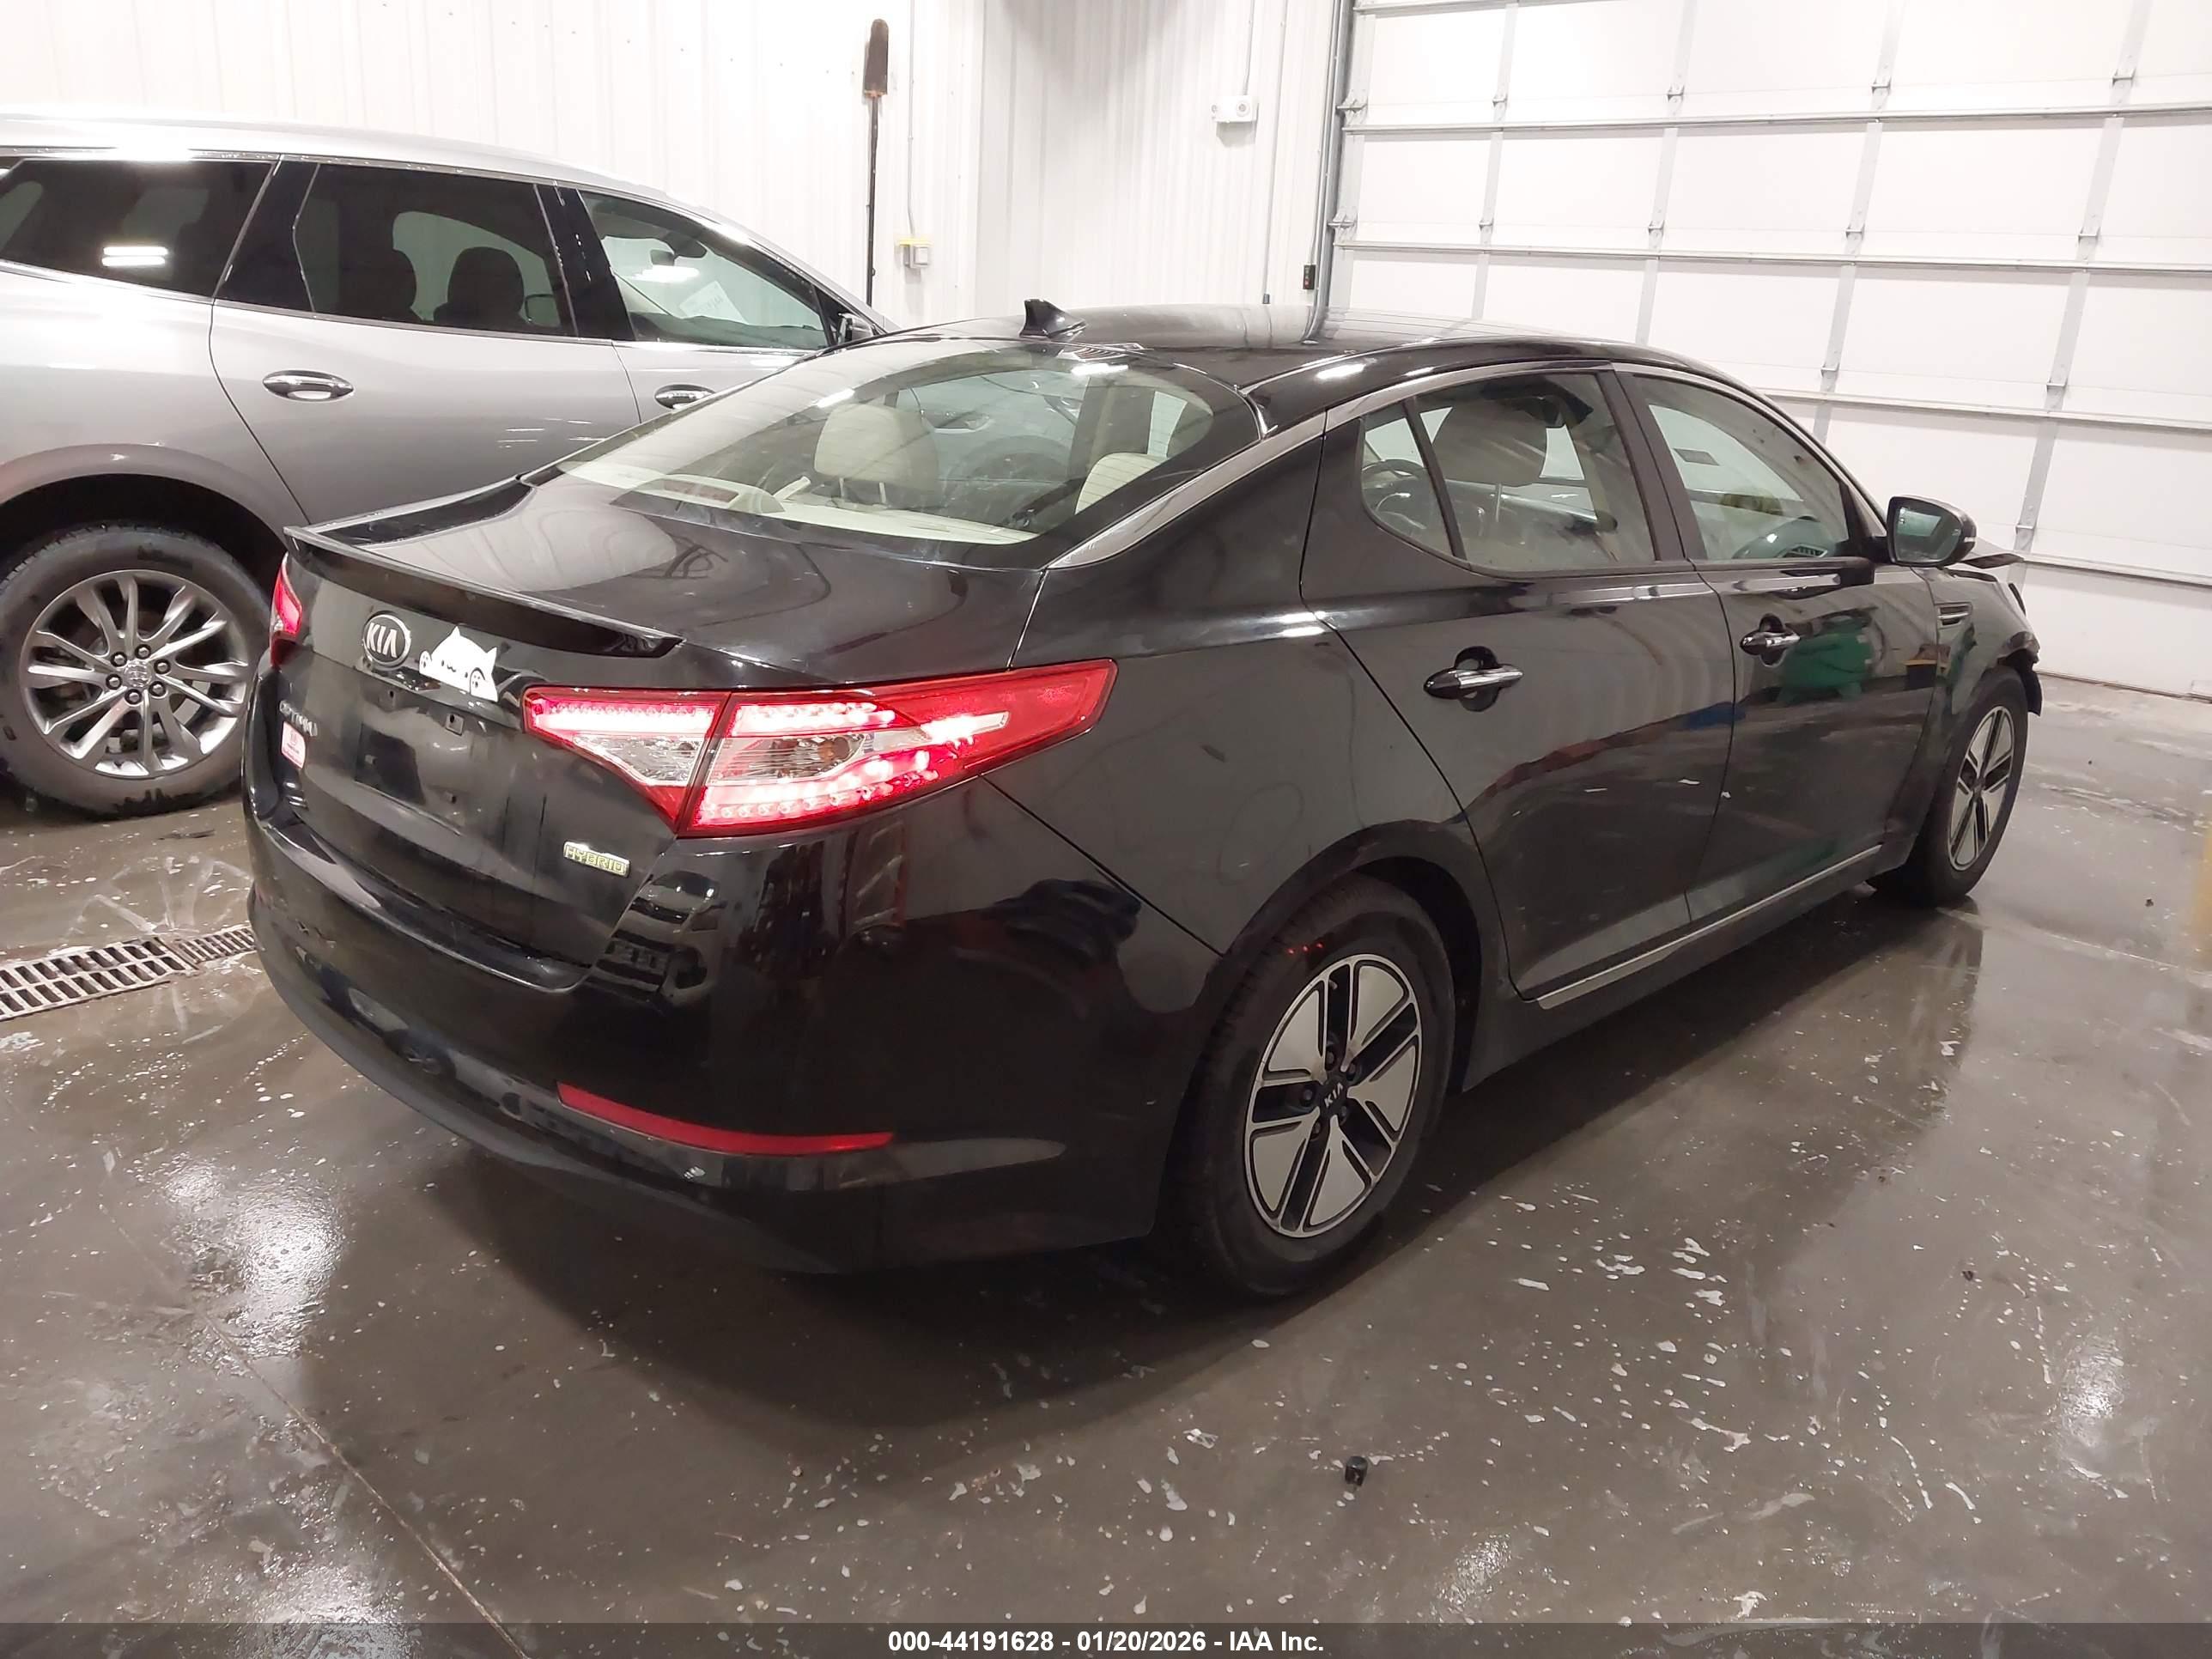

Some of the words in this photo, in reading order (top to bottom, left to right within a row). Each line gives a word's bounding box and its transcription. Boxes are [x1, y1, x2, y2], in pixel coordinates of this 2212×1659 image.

[366, 622, 398, 659] KIA
[565, 845, 626, 874] HYBRID
[1323, 1082, 1344, 1109] KIA
